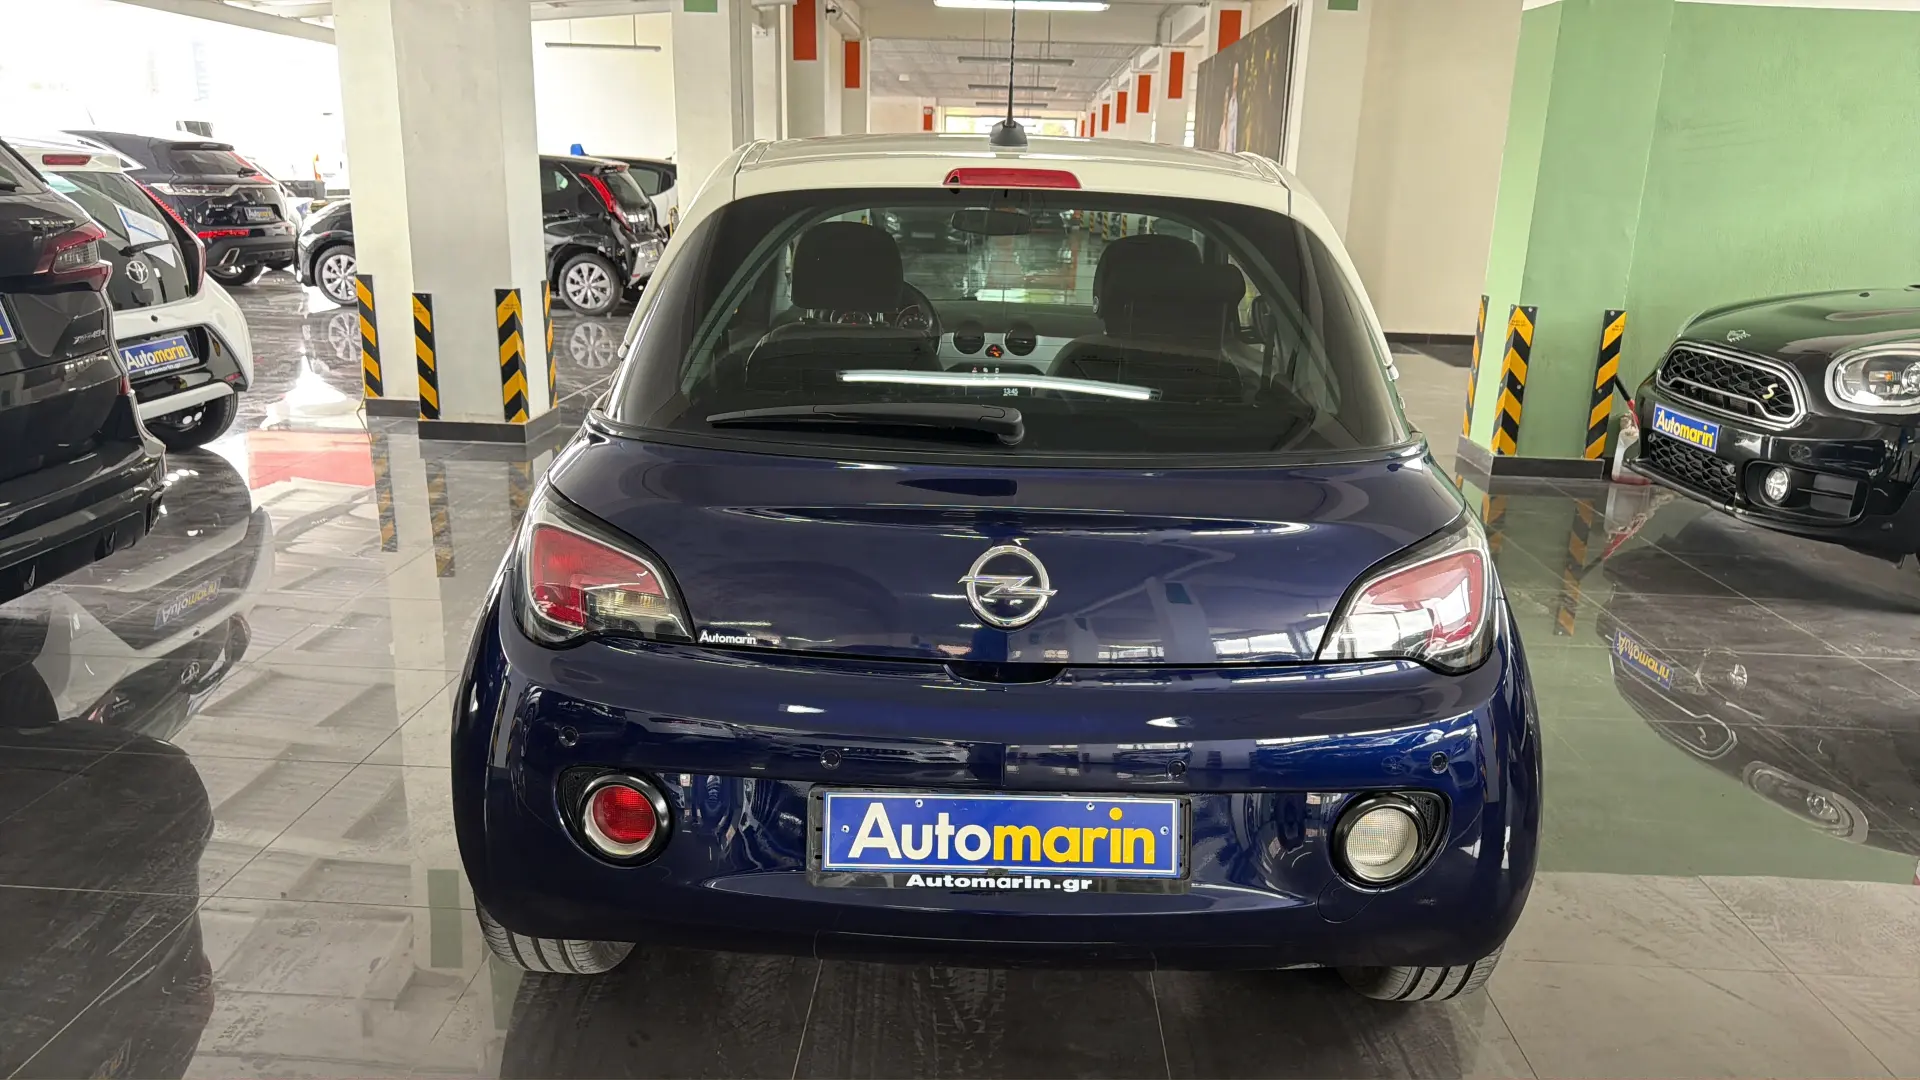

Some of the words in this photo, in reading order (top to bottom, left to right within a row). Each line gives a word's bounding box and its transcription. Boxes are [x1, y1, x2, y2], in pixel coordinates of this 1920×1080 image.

[125, 341, 188, 370] Automarin
[1762, 383, 1779, 400] S
[1656, 409, 1714, 447] Automarin
[700, 630, 757, 645] Automarin
[847, 802, 1156, 864] Automarin
[906, 874, 1093, 892] Automarin.gr
